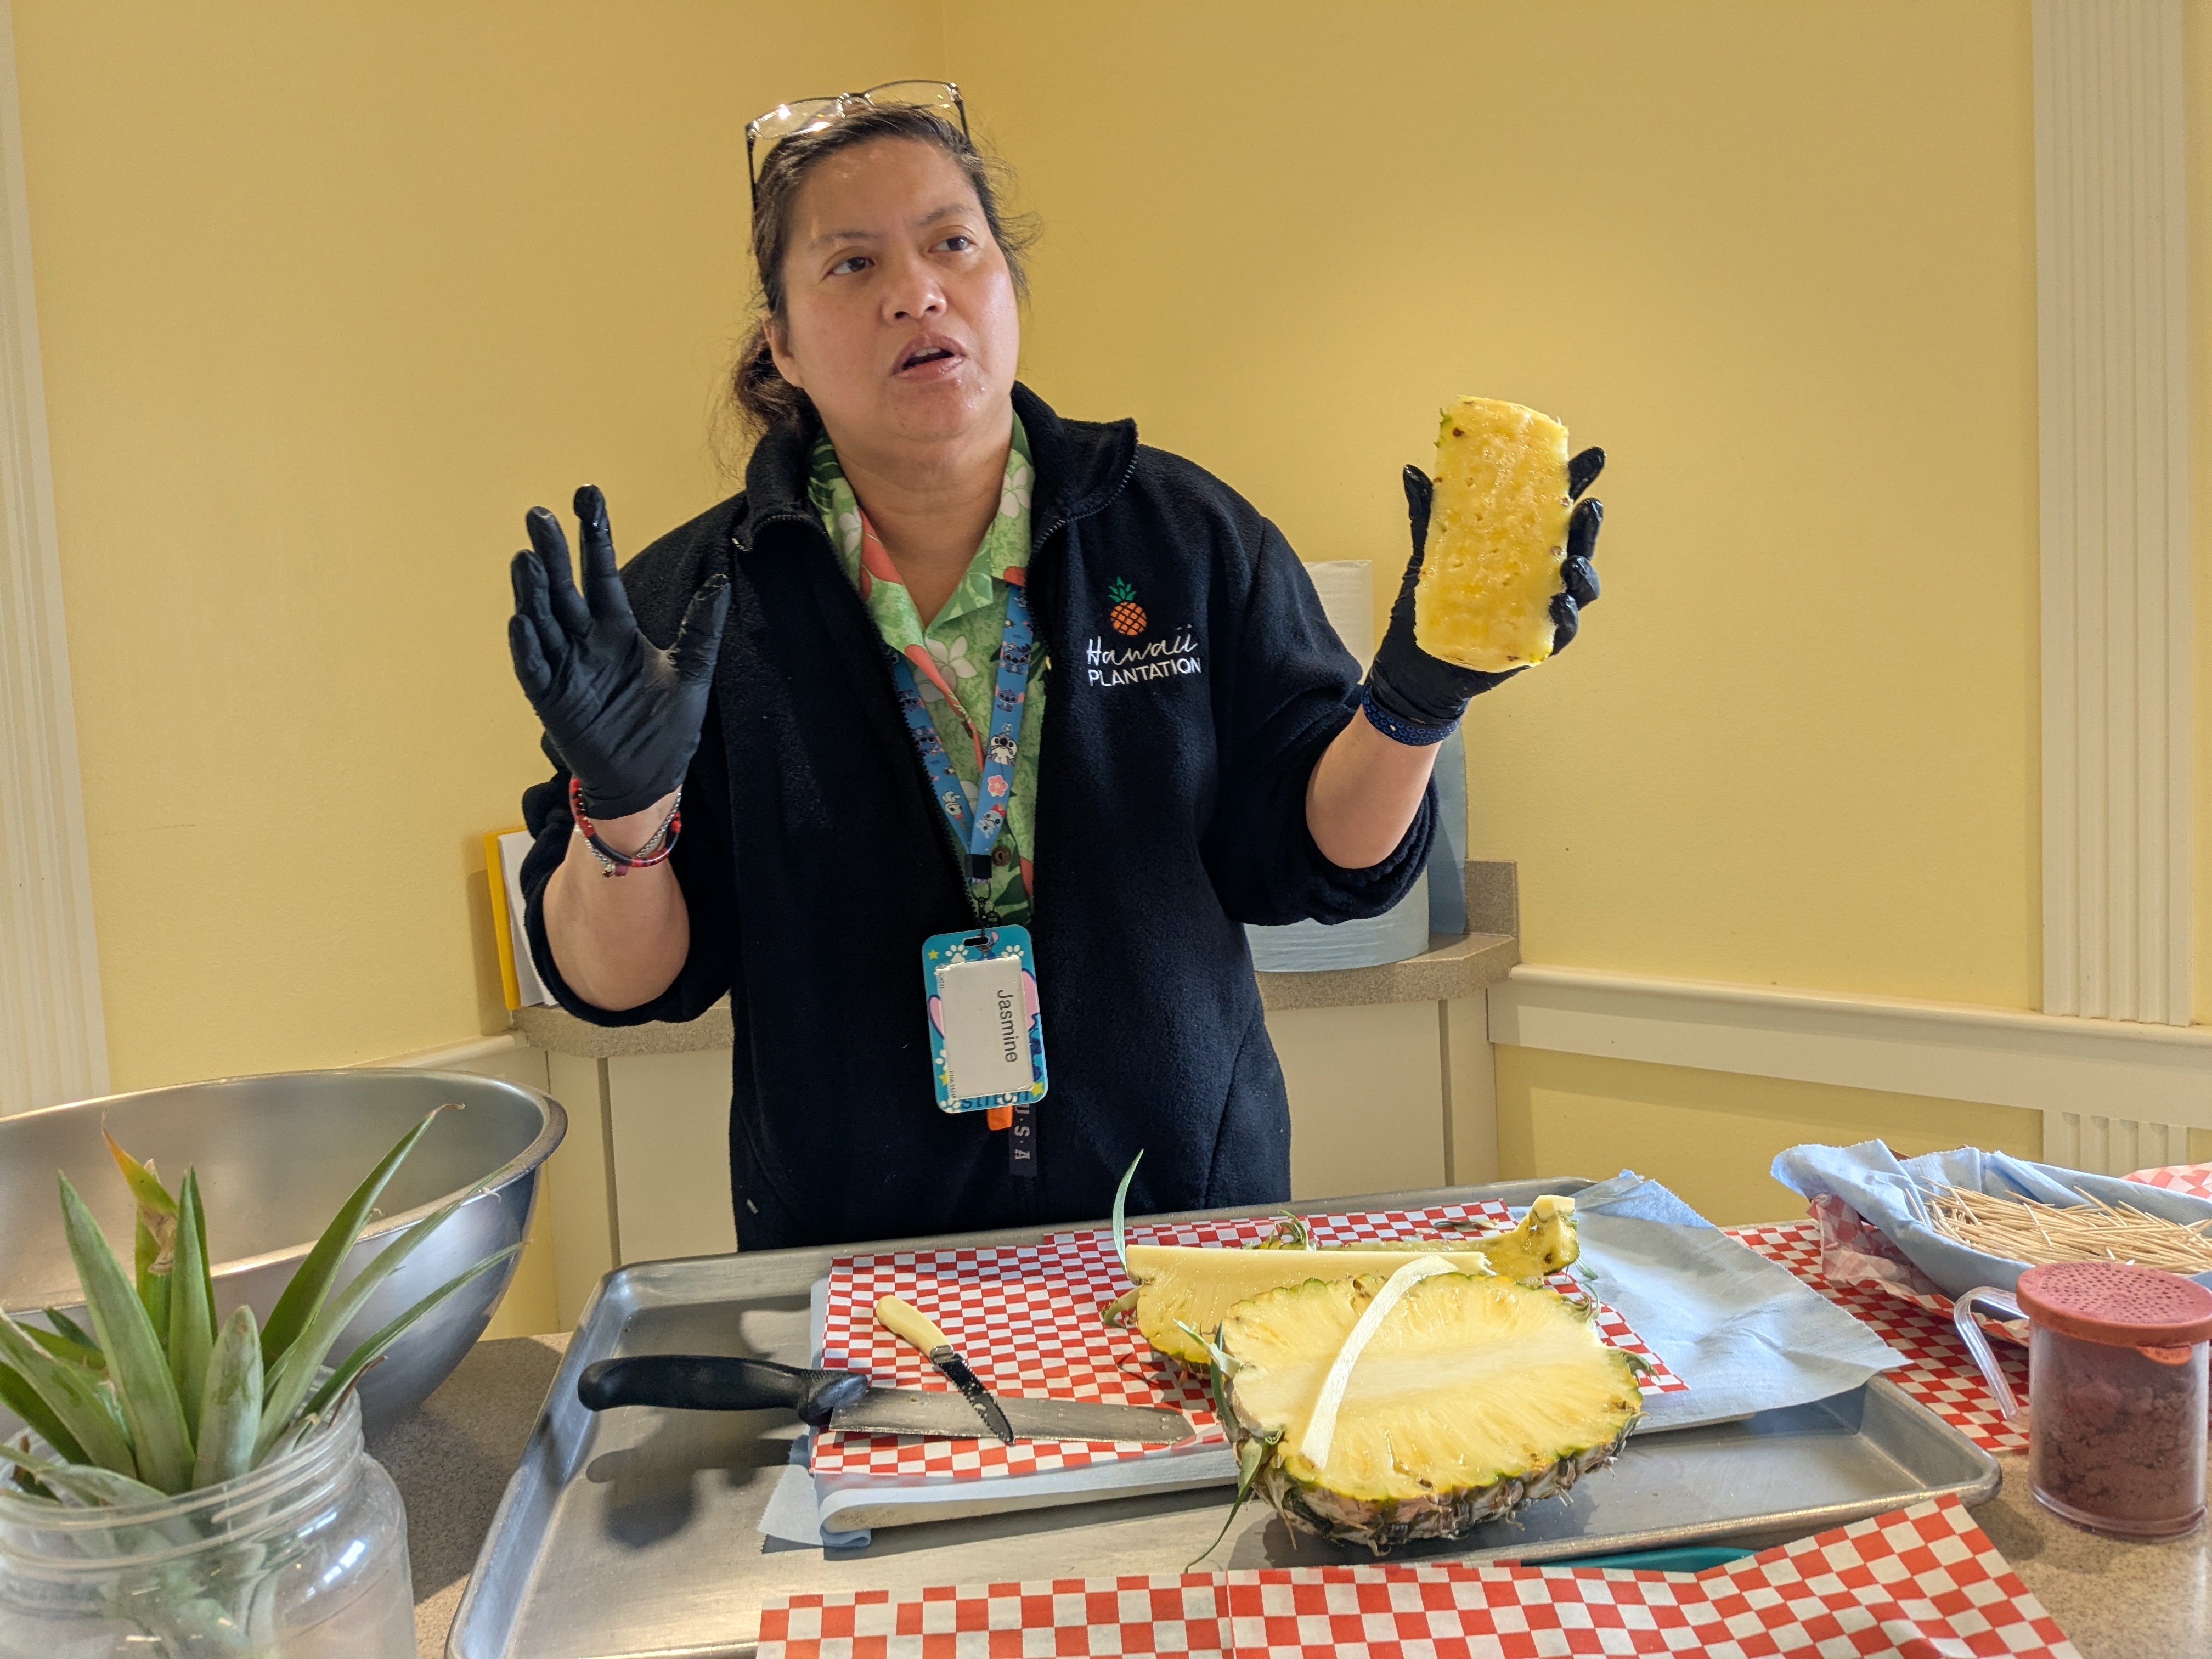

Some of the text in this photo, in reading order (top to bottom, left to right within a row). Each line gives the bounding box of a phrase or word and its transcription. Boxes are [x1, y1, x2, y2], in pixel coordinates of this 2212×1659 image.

[1086, 623, 1199, 666] Hawaii
[1087, 657, 1202, 687] PLANTATION
[997, 989, 1019, 1063] Jasmine
